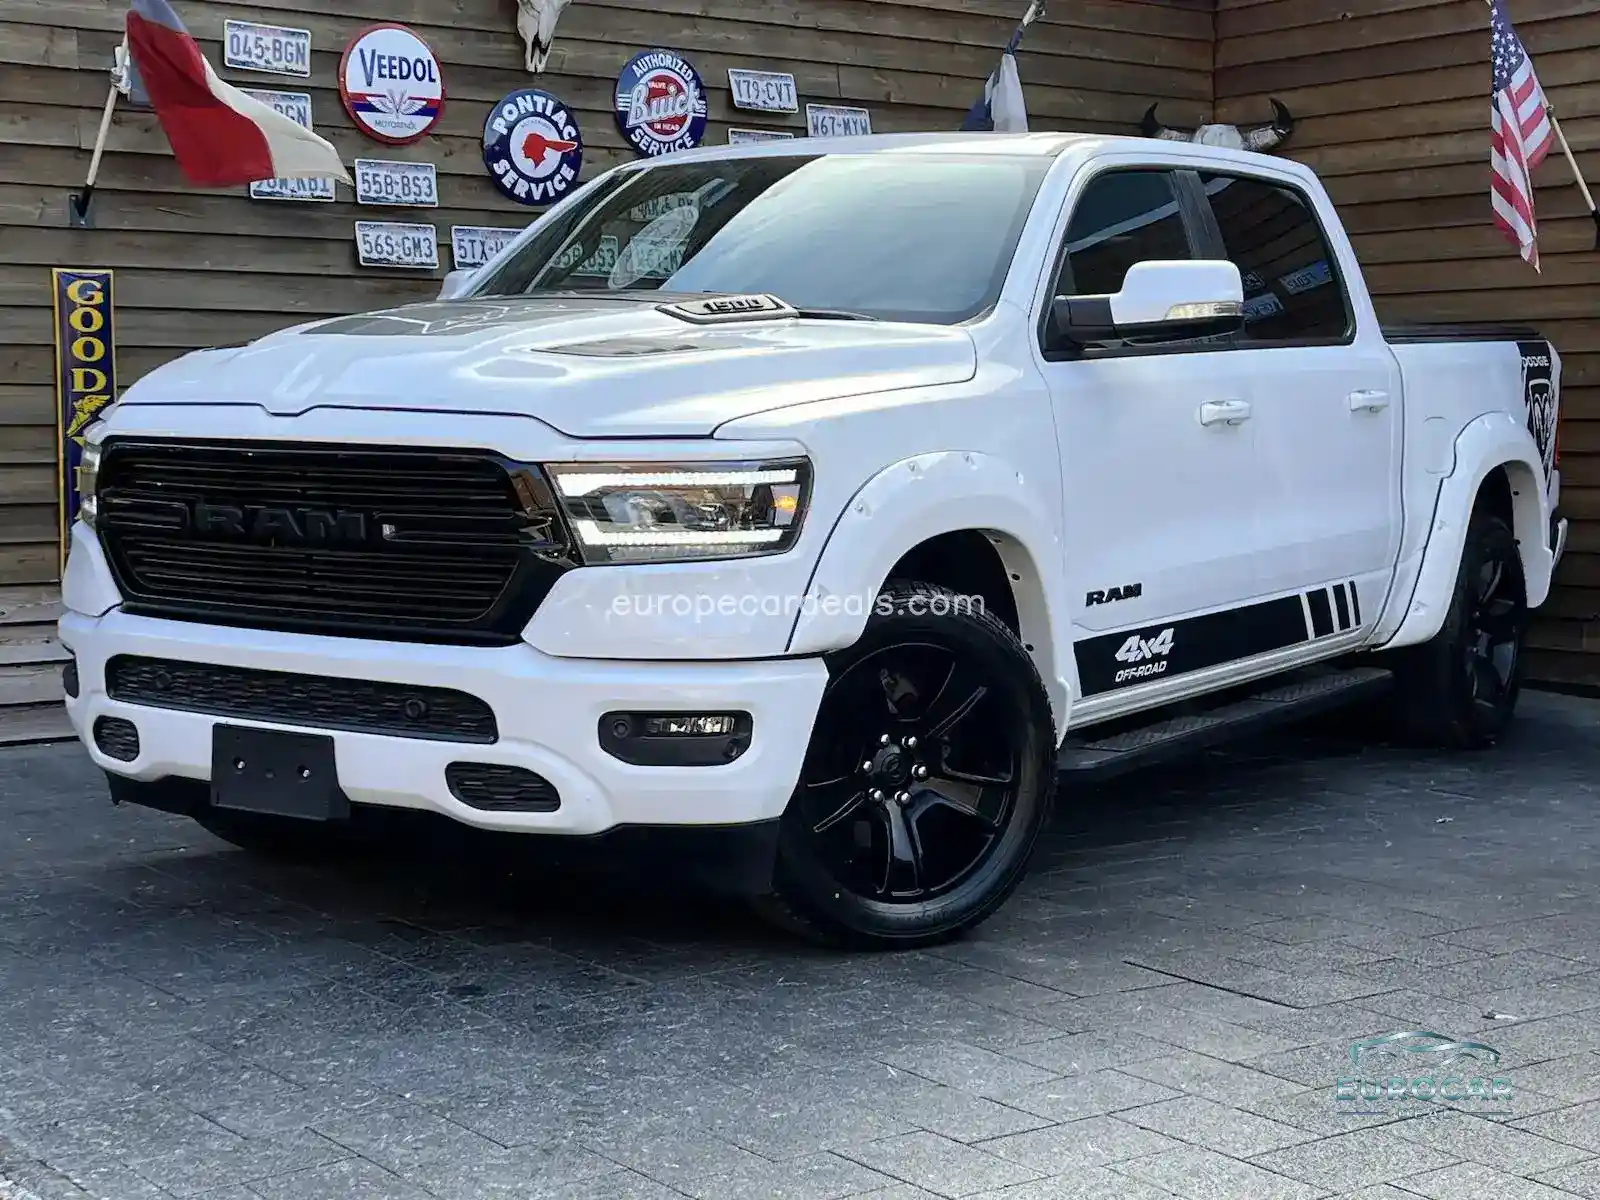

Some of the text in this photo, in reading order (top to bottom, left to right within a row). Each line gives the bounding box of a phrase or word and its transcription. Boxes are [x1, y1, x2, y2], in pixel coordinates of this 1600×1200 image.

[359, 48, 437, 88] VEEDOL
[631, 53, 694, 81] AUTHORIZED
[492, 95, 577, 136] PONTIAC
[626, 80, 702, 128] Buick
[630, 128, 695, 156] SERVICE
[493, 159, 575, 200] SERVICE
[67, 279, 107, 393] GOOD
[1521, 355, 1550, 368] DODGE
[195, 504, 366, 541] RAM
[1085, 582, 1142, 608] RAM
[1115, 660, 1168, 683] OFF-ROAD
